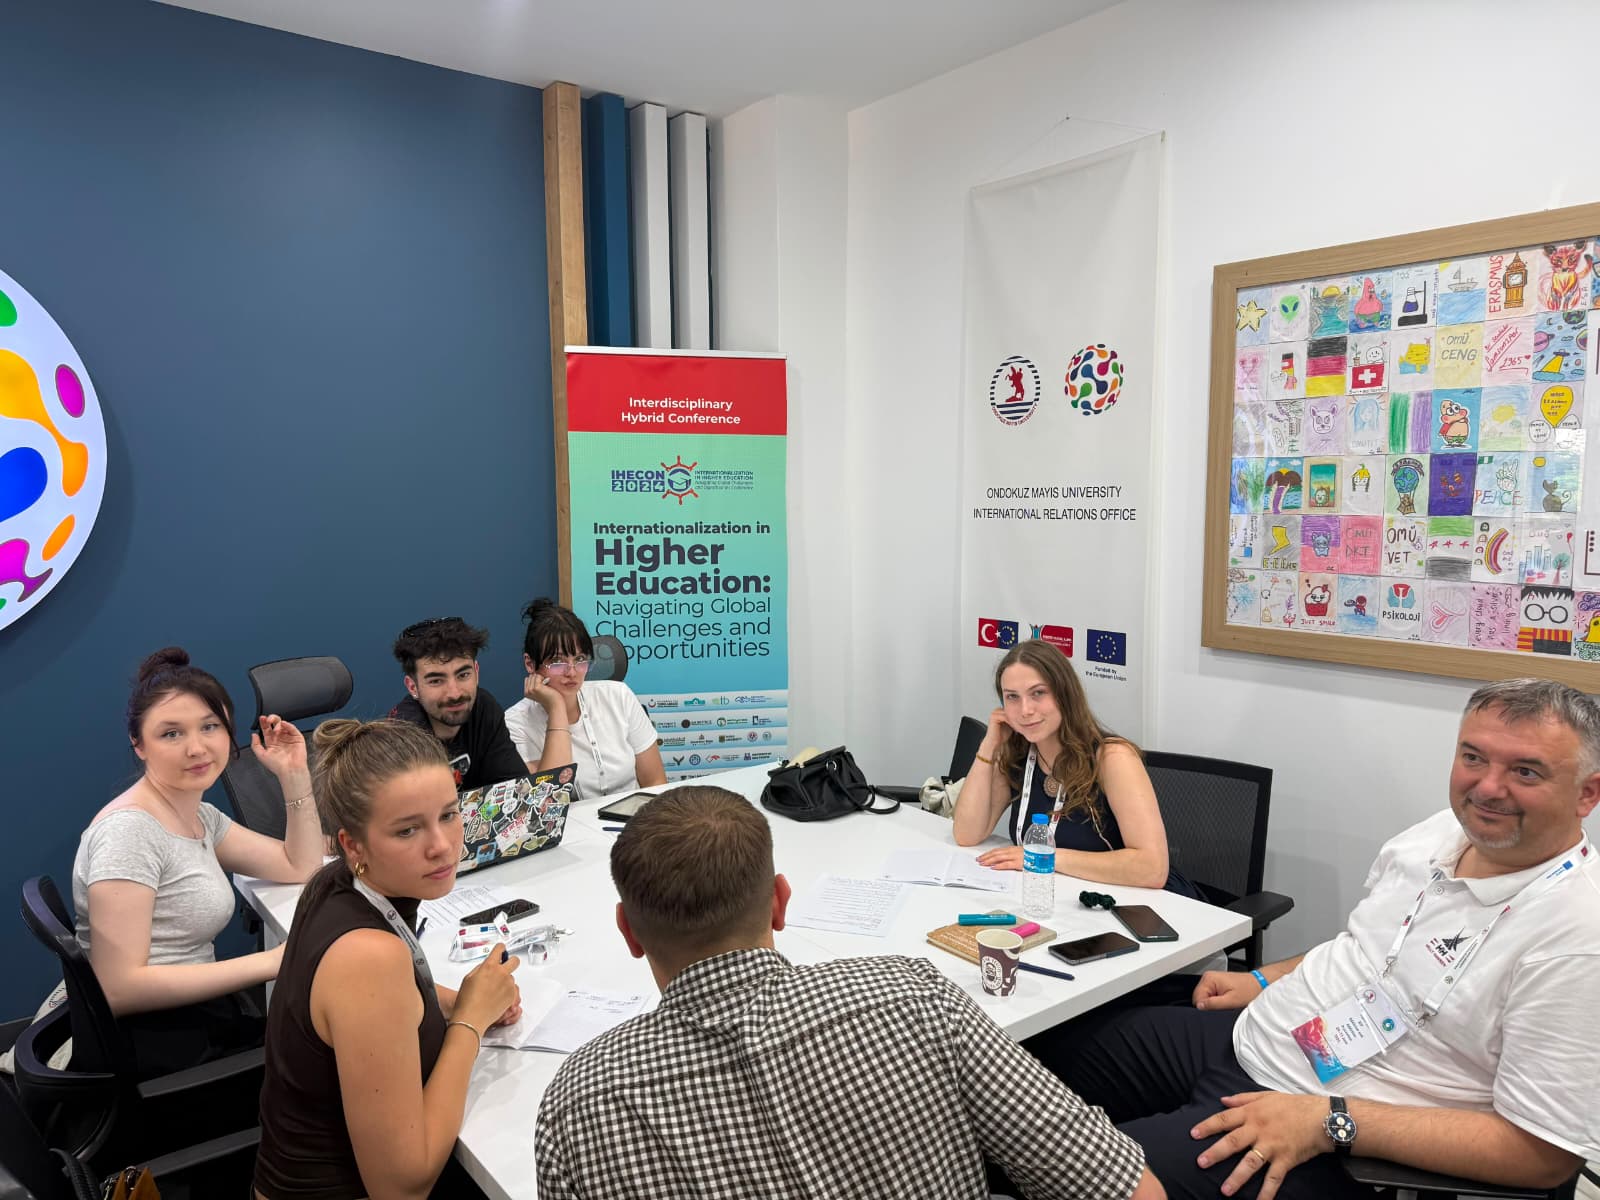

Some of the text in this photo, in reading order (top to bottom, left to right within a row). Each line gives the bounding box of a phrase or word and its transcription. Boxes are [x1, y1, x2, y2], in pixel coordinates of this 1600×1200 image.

[1488, 255, 1504, 313] ERASMUS
[1441, 348, 1478, 361] CENG
[629, 397, 733, 412] Interdisciplinary
[621, 411, 741, 425] Hybrid Conference
[611, 470, 665, 480] IHECON
[611, 480, 665, 492] 2024
[986, 486, 1122, 499] ONDOKUZ MAYIS UNIVERSITY
[973, 508, 1136, 521] INTERNATIONAL RELATIONS OFFICE
[593, 521, 770, 535] Internationalization in
[1386, 525, 1417, 544] OMÜ
[595, 535, 725, 573] Higher
[1387, 551, 1411, 564] VET
[595, 567, 771, 595] Education:
[596, 597, 771, 619] Navigating Global
[595, 617, 771, 642] Challenges and
